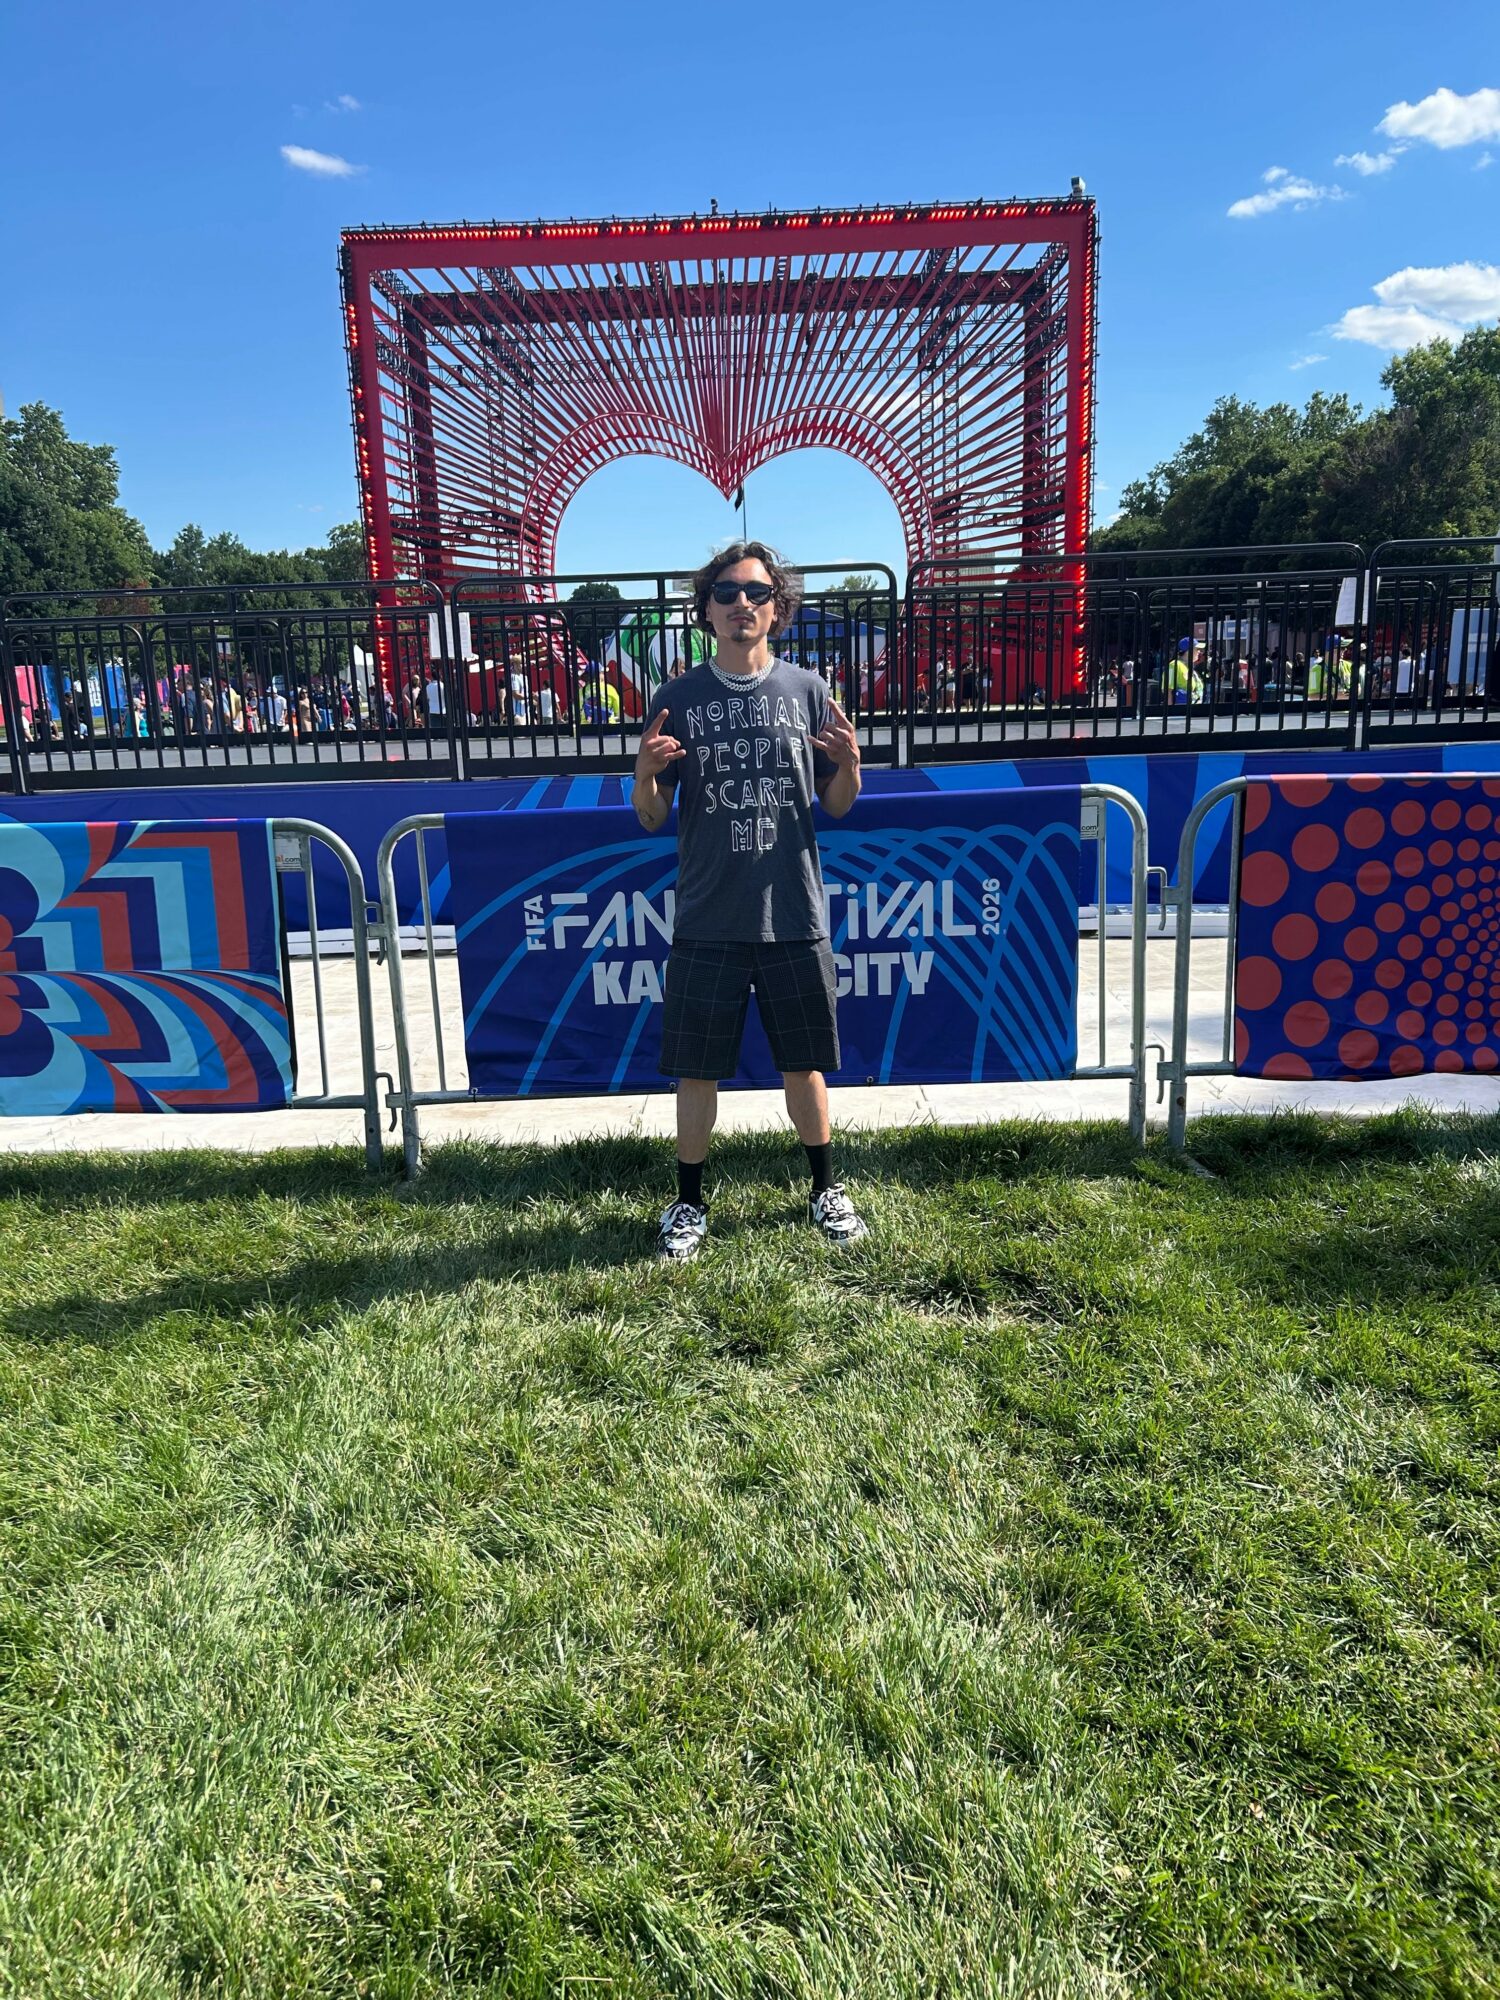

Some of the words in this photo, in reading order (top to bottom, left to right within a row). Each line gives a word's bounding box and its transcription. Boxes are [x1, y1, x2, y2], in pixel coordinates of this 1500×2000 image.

[686, 695, 806, 739] NORMAL
[697, 738, 804, 776] PEOPLE
[705, 777, 795, 814] SCARE
[731, 817, 775, 852] ME
[523, 894, 547, 950] FIFA
[550, 889, 677, 950] FAN
[982, 878, 1001, 936] 2026
[833, 951, 935, 998] CITY
